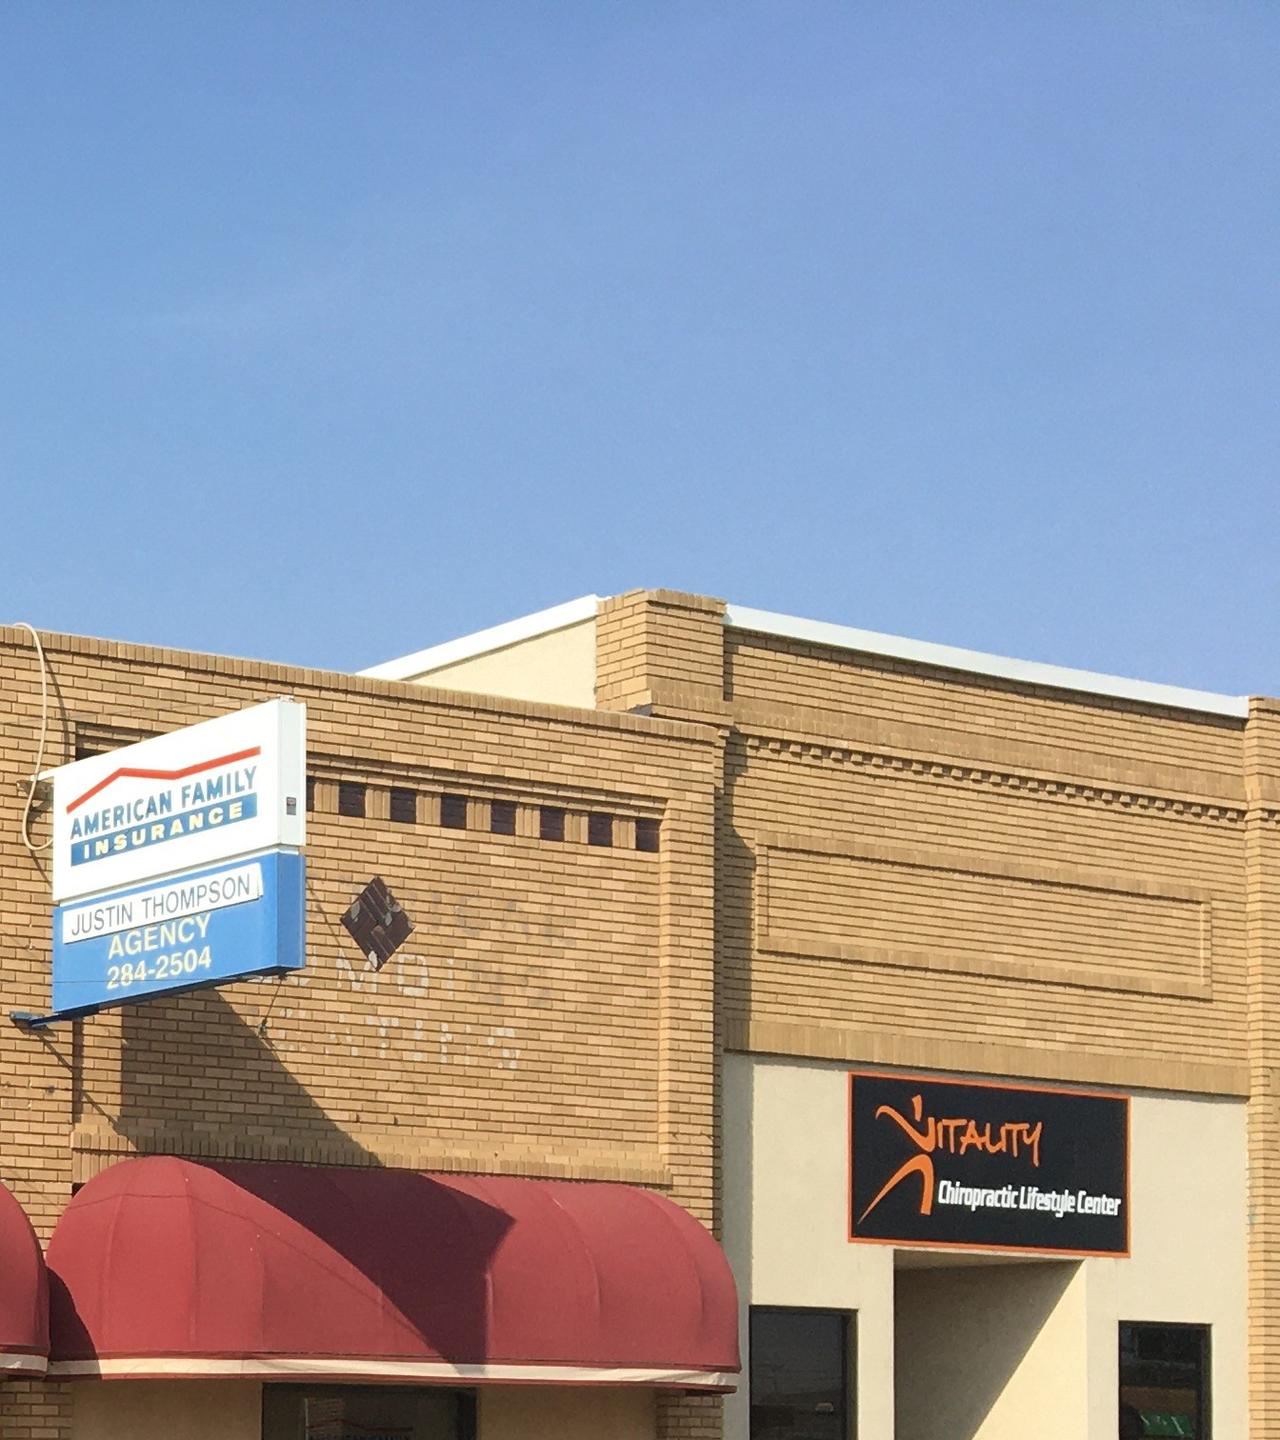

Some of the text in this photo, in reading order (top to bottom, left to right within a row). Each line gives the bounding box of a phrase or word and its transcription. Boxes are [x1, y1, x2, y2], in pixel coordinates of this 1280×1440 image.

[71, 766, 257, 839] AMERICAN FAMILY
[83, 804, 244, 860] INSURANCE
[71, 874, 251, 936] JUSTIN THOMPSON
[108, 913, 212, 960] AGENCY
[106, 946, 212, 990] 284-2504
[875, 1094, 1043, 1168] VITALITY
[938, 1180, 1121, 1218] Chiropractic Lifestyle Center
